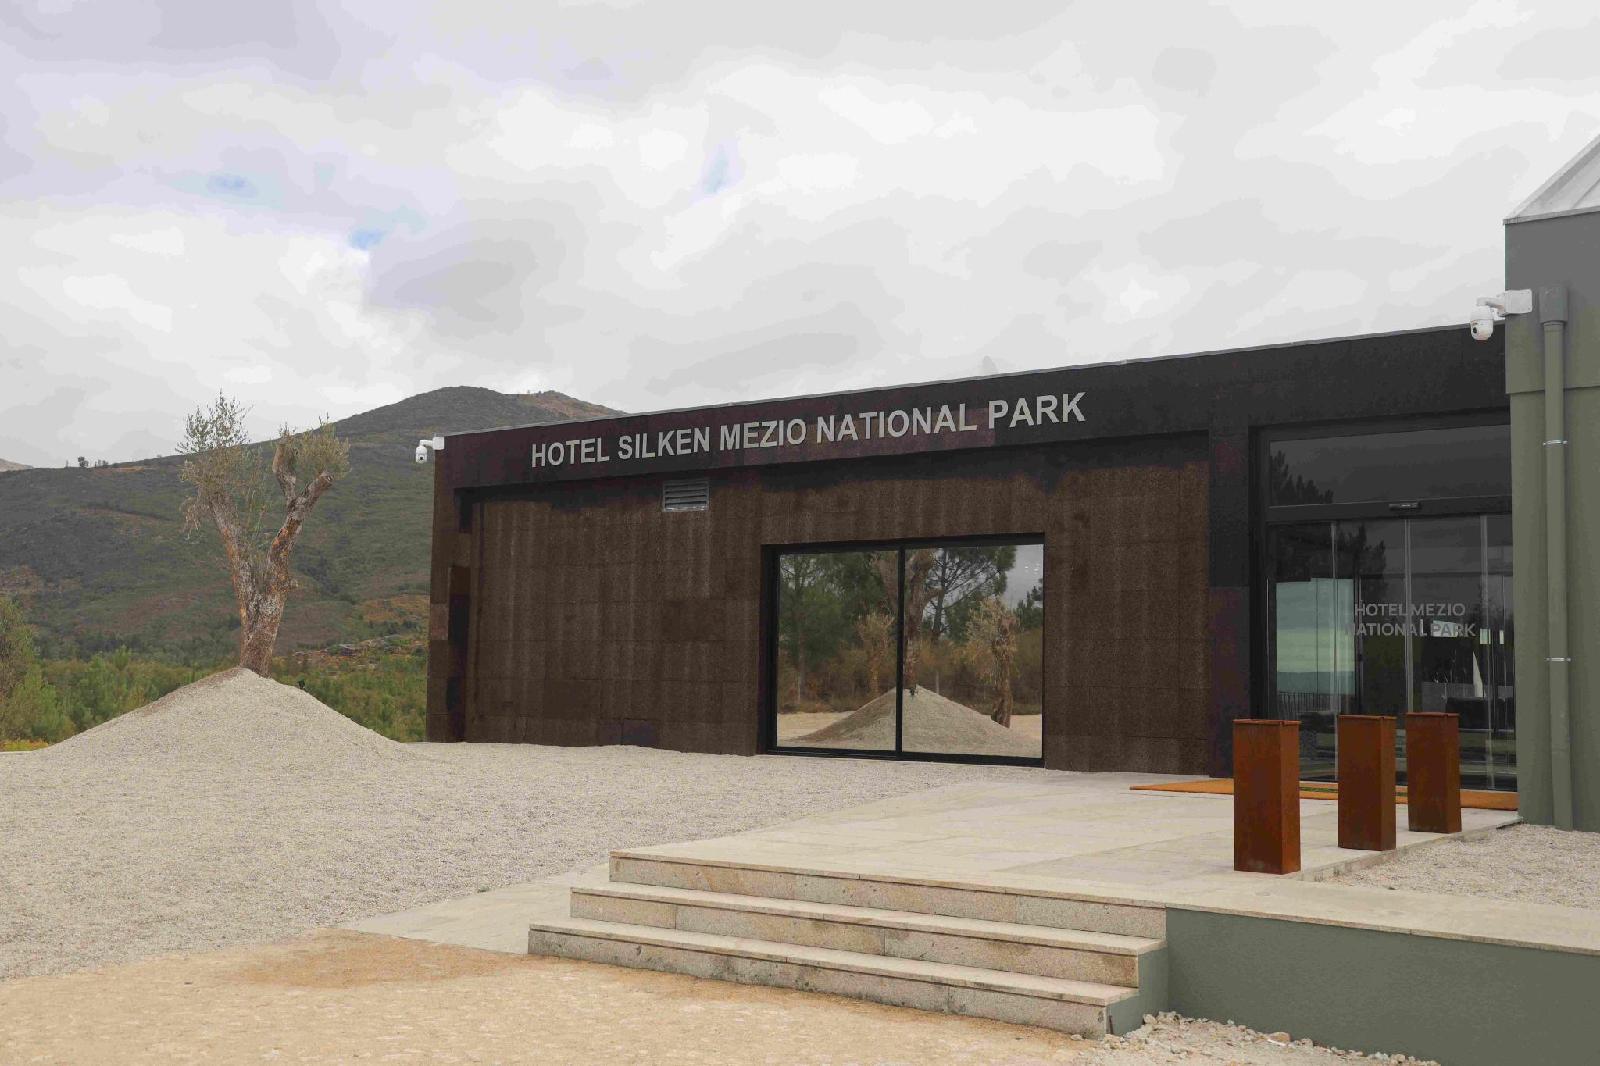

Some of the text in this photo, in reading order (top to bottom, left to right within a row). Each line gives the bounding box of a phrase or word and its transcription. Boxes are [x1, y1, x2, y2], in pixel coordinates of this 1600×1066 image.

[531, 391, 1086, 468] HOTEL SILKEN MEZIO NATIONAL PARK
[1354, 603, 1466, 617] HOTEL MEZIO
[1430, 623, 1476, 637] PARK
